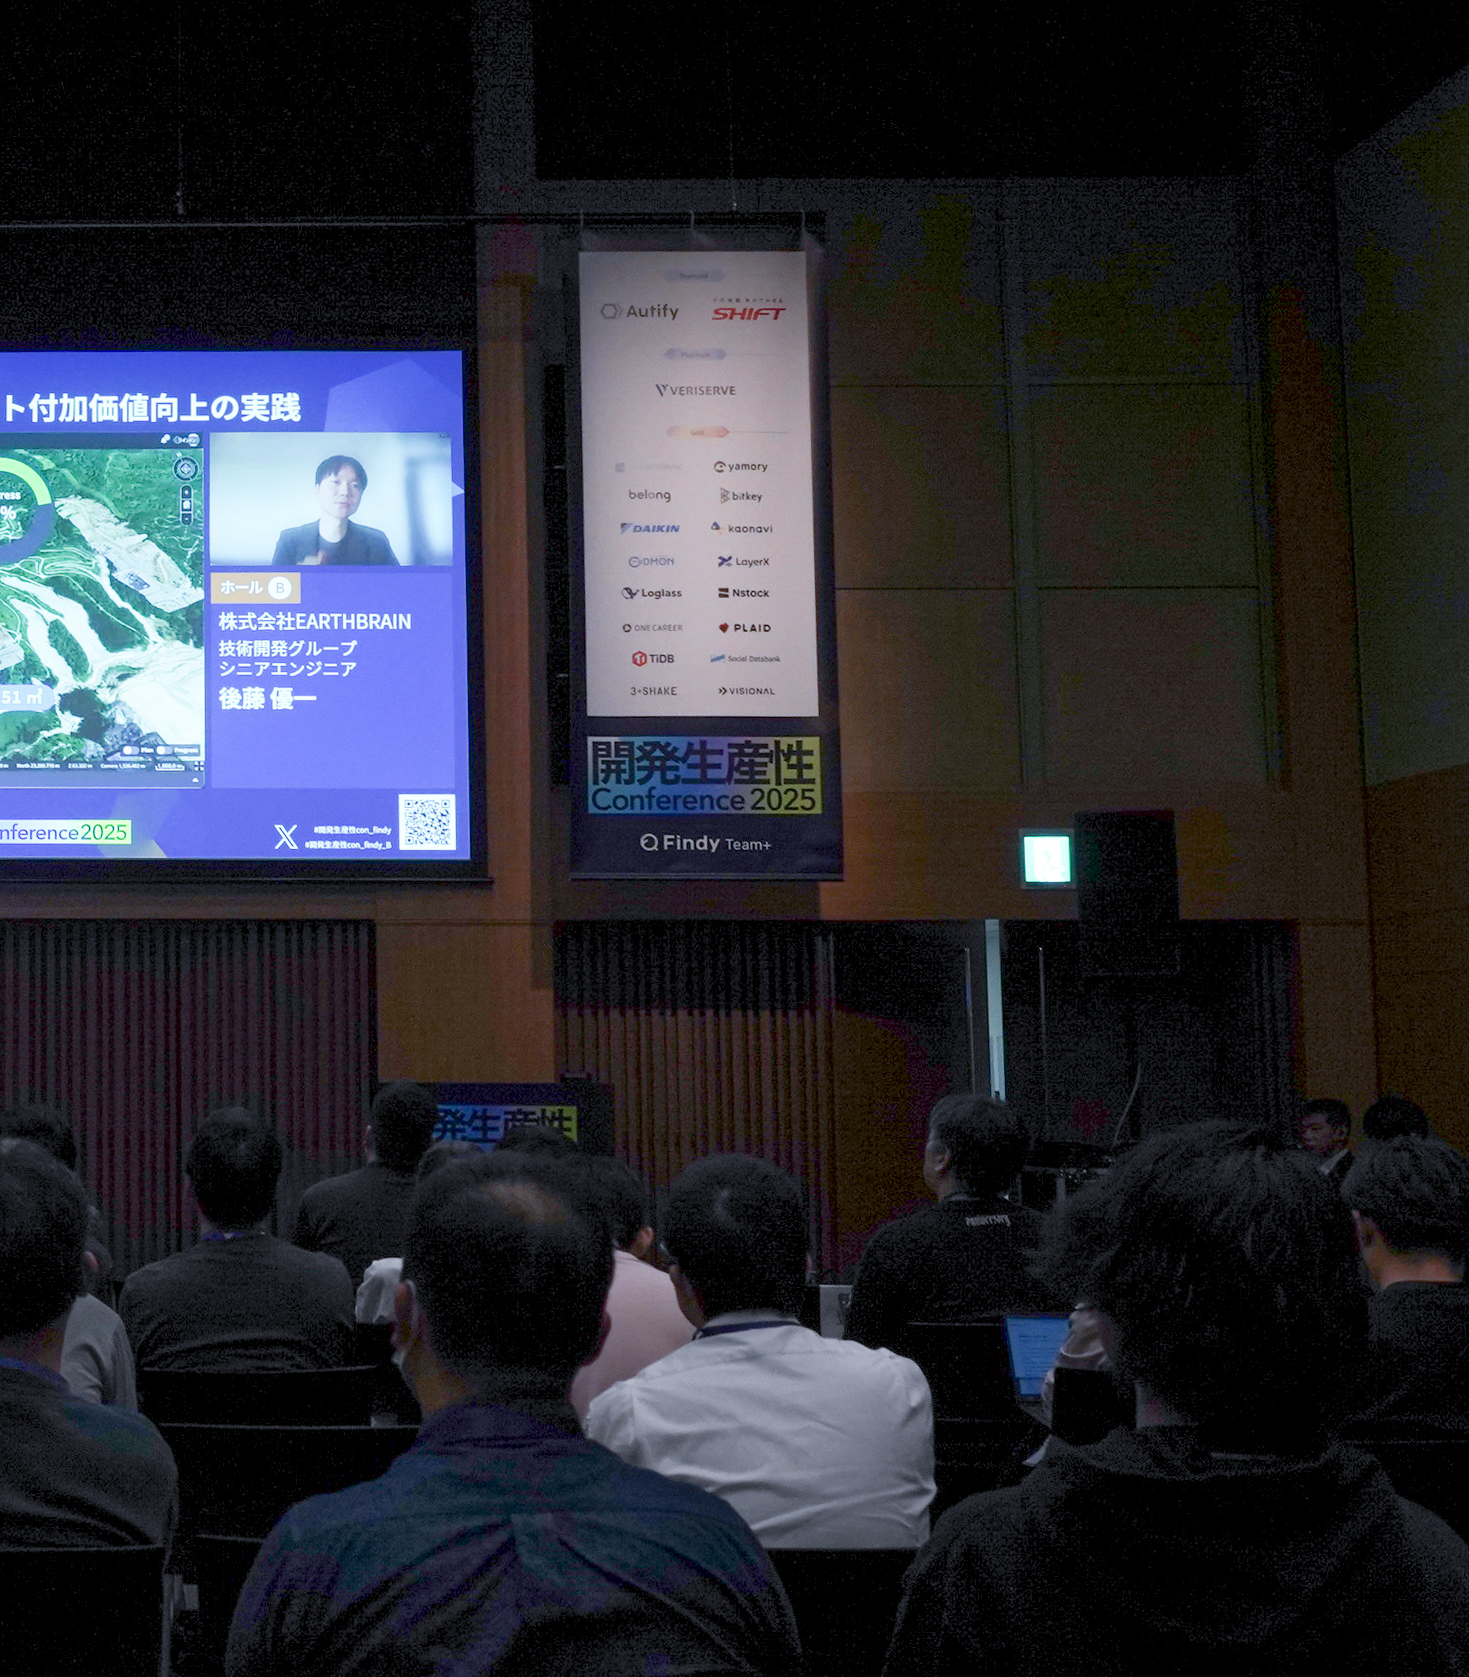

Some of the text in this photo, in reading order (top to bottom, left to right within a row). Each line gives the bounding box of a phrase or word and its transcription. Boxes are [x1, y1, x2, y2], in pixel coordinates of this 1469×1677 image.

[626, 304, 679, 320] Autify
[712, 308, 786, 320] SHIFT
[670, 386, 736, 396] VERISERVE
[728, 462, 768, 472] yamory
[628, 490, 671, 502] belong
[732, 492, 762, 502] bitkey
[633, 524, 680, 532] DAIKIN
[728, 524, 773, 533] kaonavi
[736, 558, 770, 568] LayerX
[220, 581, 263, 594] ホール
[642, 588, 682, 599] Loglass
[732, 589, 770, 598] Nstock
[219, 612, 412, 631] 株式会社EARTHBRAIN
[634, 624, 682, 632] ONE CAREER
[734, 624, 771, 632] PLAID
[219, 640, 358, 657] 技術開発グループ
[650, 654, 674, 664] TiDB
[220, 662, 356, 676] シニアエンジニア
[729, 688, 775, 696] VISIONAL
[219, 687, 317, 710] 後藤 優一
[592, 740, 816, 786] 開発生産性
[592, 786, 816, 811] Conference 2025
[663, 834, 772, 852] Findy Team+
